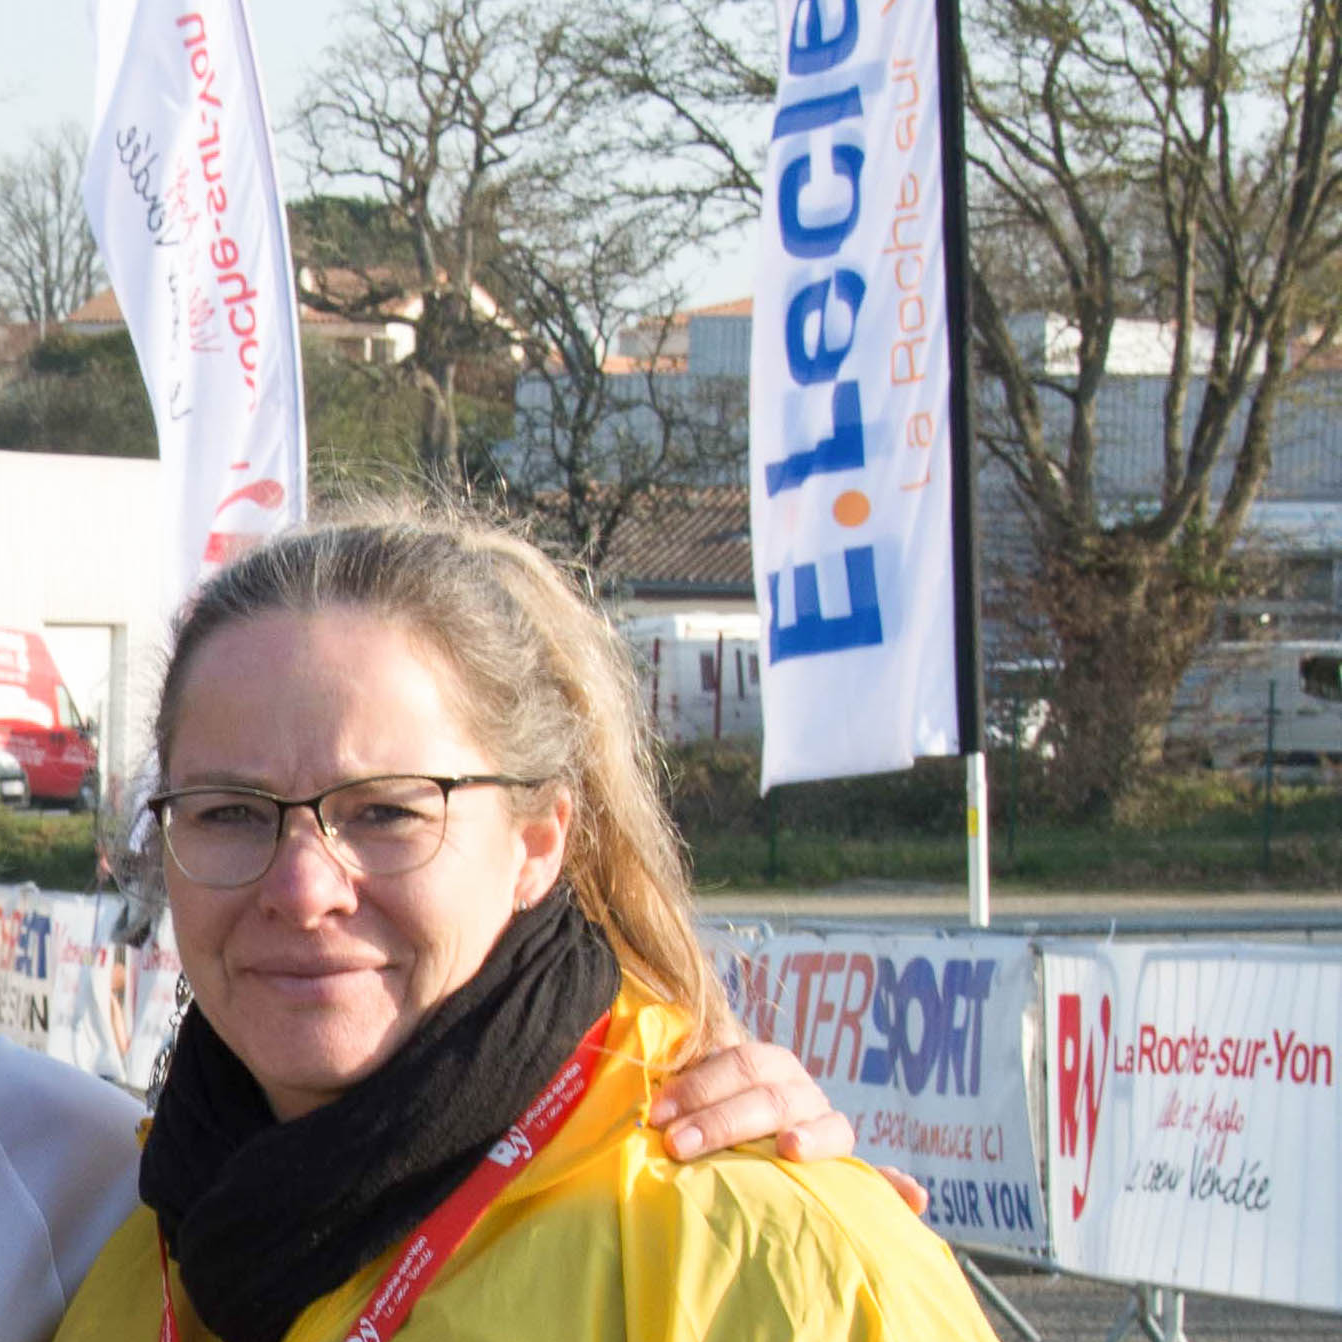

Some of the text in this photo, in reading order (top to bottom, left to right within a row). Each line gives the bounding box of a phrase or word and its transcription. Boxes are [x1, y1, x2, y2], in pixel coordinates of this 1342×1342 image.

[883, 172, 927, 387] Roche
[940, 1178, 986, 1228] SUR
[985, 1180, 1035, 1232] YON
